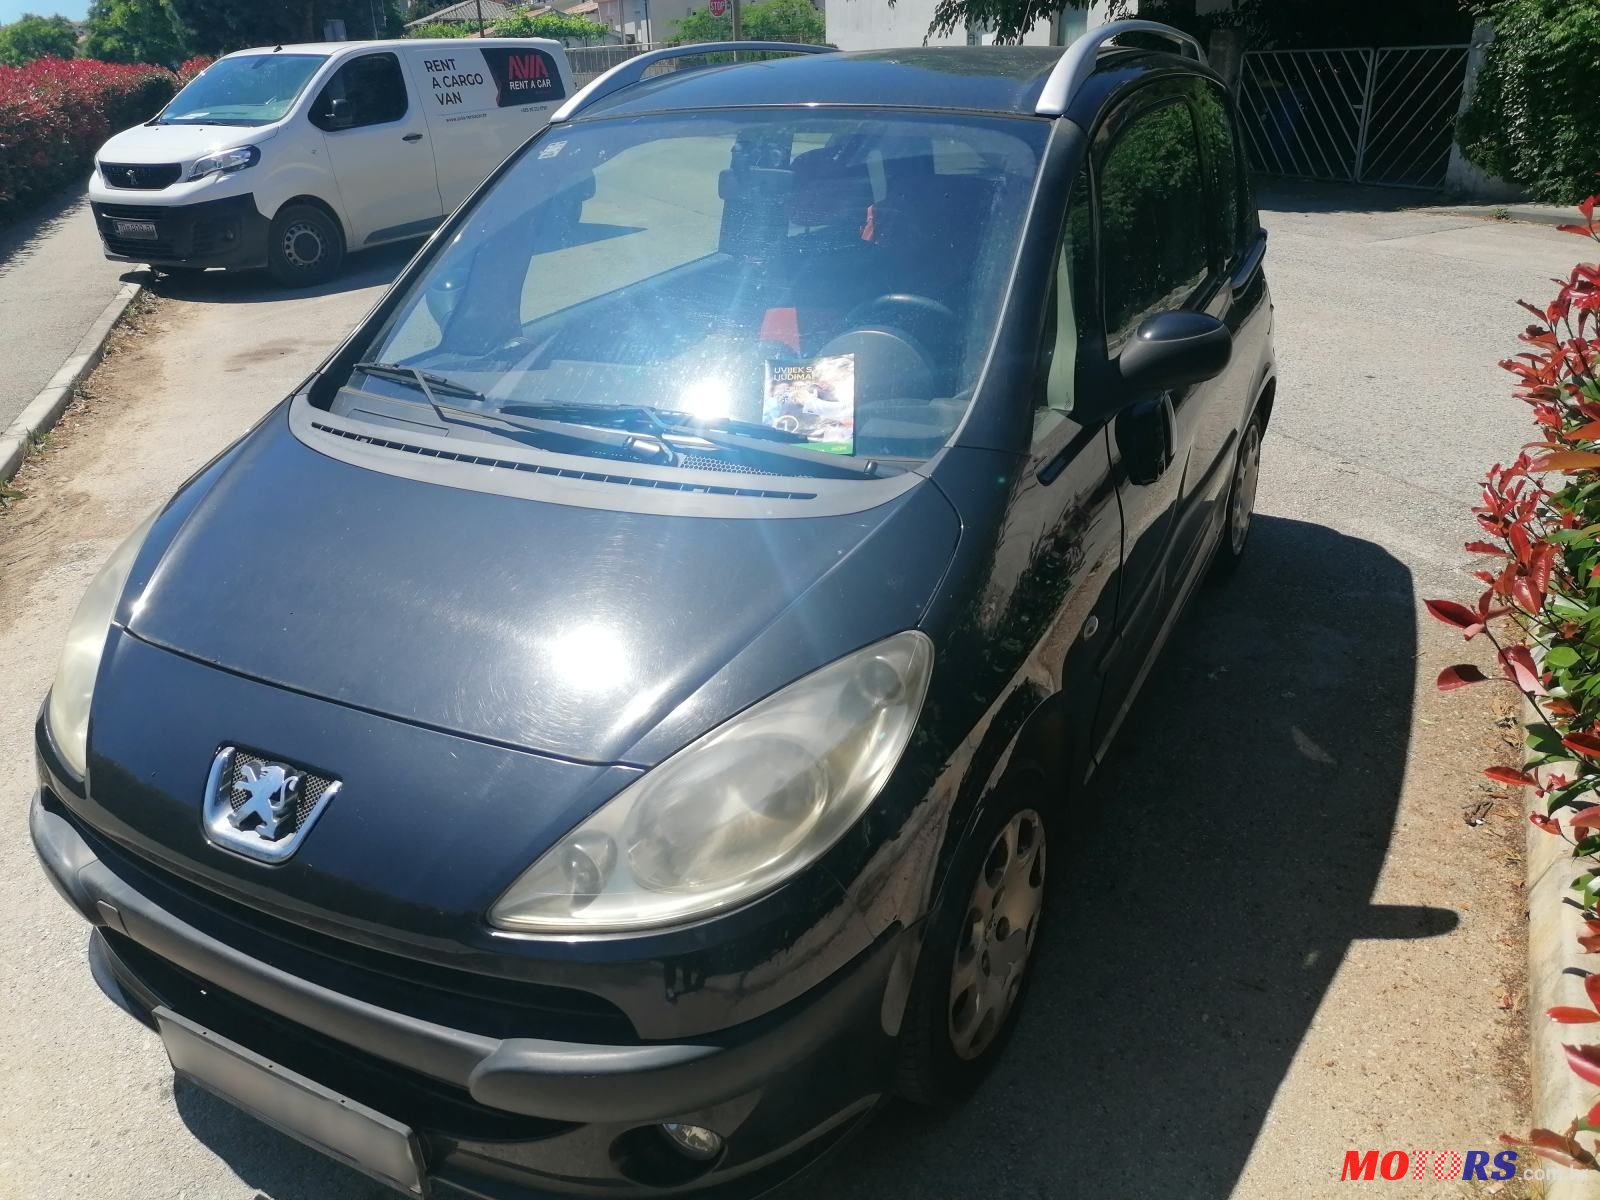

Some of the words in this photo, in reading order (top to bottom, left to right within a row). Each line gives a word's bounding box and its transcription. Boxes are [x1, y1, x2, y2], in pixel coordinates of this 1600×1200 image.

[710, 1, 725, 10] STOP
[424, 58, 457, 73] RENT
[432, 78, 442, 89] A
[442, 73, 484, 88] CARGO
[509, 80, 529, 90] RENT
[530, 79, 536, 89] A
[536, 78, 552, 89] CAR
[435, 91, 463, 106] VAN
